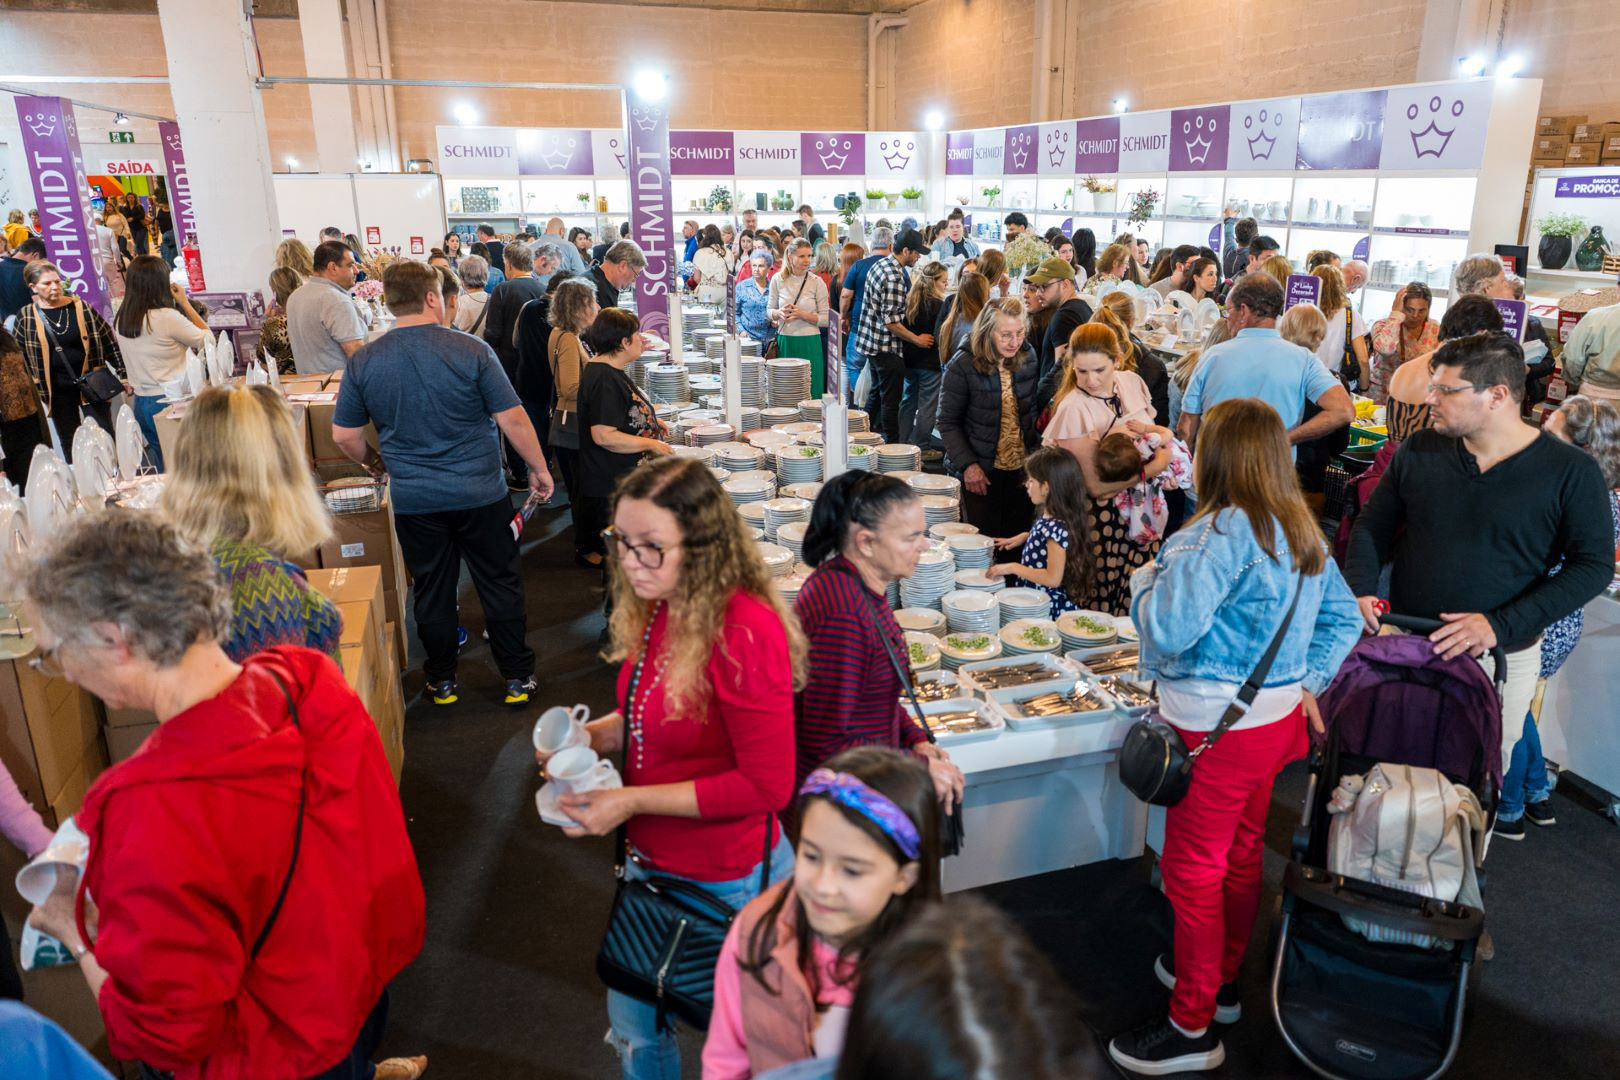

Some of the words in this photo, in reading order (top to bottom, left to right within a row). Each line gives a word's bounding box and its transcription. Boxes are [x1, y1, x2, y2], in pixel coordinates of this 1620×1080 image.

[1078, 138, 1118, 155] SCHMIDT
[1122, 134, 1168, 152] SCHMIDT
[444, 145, 513, 158] SCHMIDT
[670, 147, 731, 160] SCHMIDT
[739, 147, 798, 160] SCHMIDT
[947, 147, 973, 161] SCHMIDT
[975, 145, 1003, 160] SCHMIDT
[107, 160, 155, 174] SAÍDA
[1573, 183, 1620, 195] PROMOÇ
[34, 151, 89, 294] SCHMIDT
[72, 151, 108, 292] SCHMIDT
[637, 146, 668, 296] SCHMIDT
